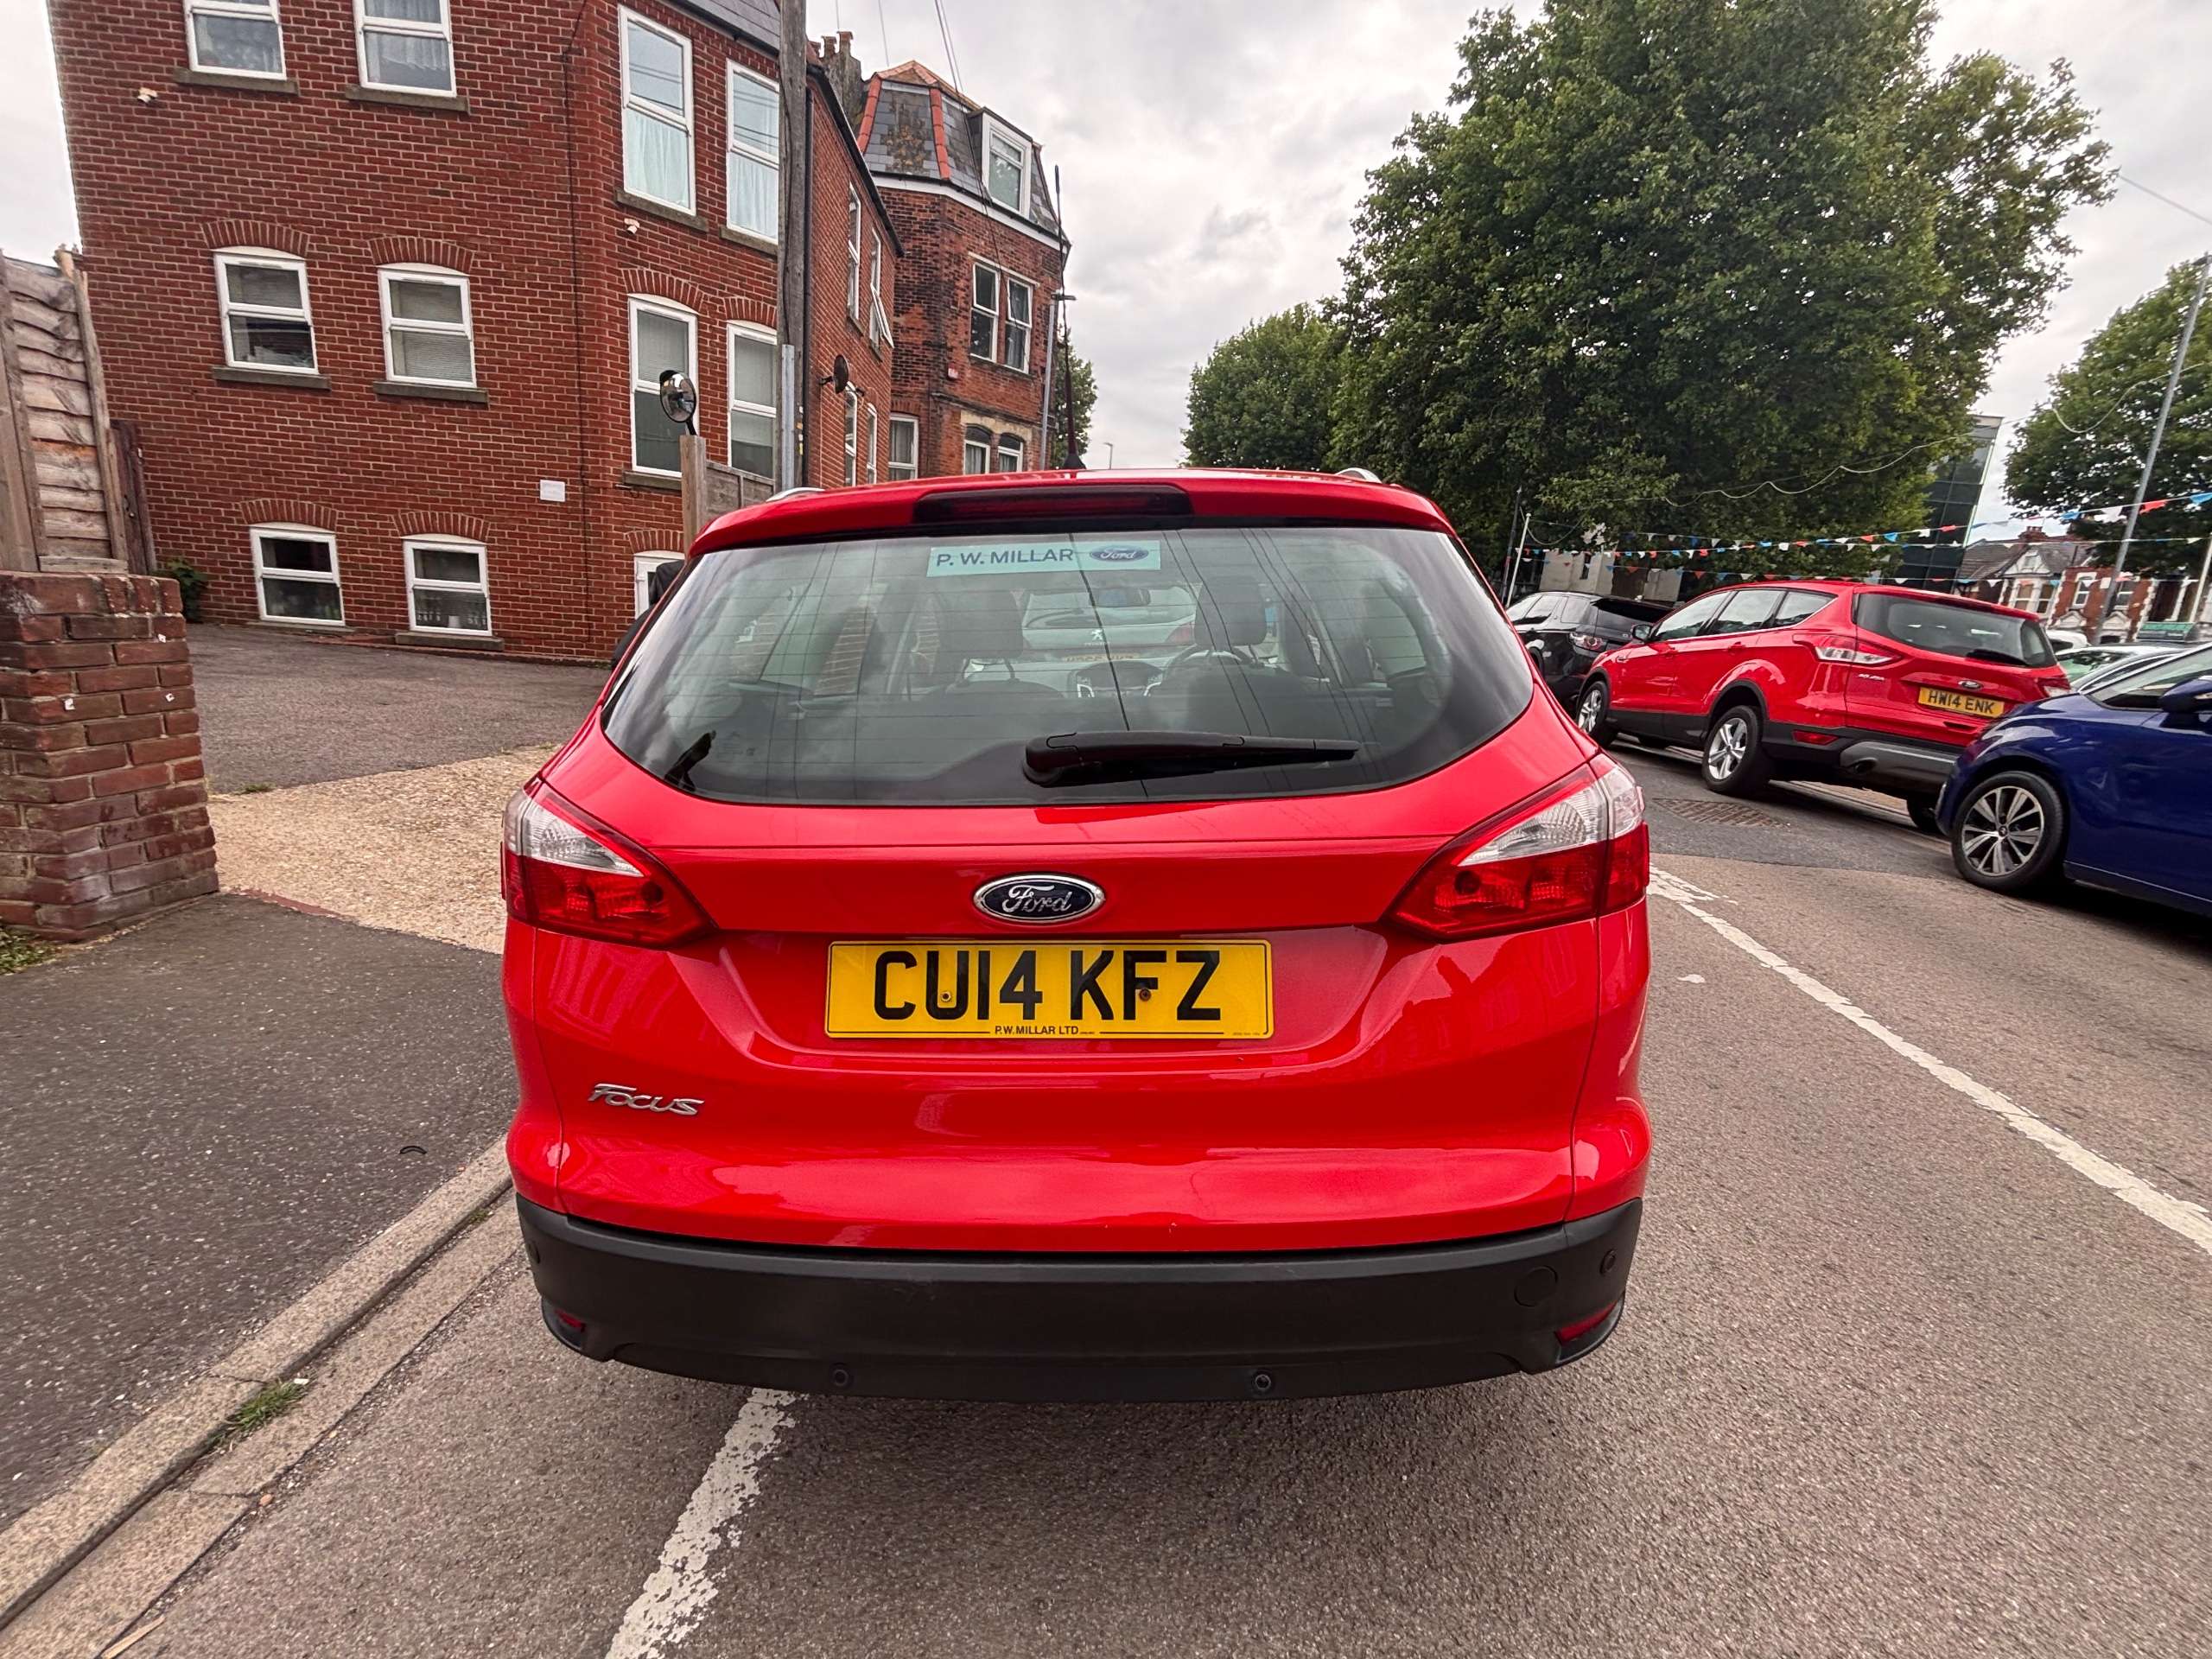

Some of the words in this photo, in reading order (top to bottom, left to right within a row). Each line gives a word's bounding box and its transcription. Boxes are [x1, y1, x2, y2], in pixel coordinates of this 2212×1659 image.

[936, 554, 954, 567] P.
[960, 551, 984, 565] W.
[990, 548, 1074, 564] MILLAR
[1964, 698, 1995, 715] ENK
[1001, 884, 1073, 912] Ford
[874, 950, 1043, 1020] CU14
[1070, 950, 1221, 1020] KFZ
[1058, 1026, 1079, 1035] LTD
